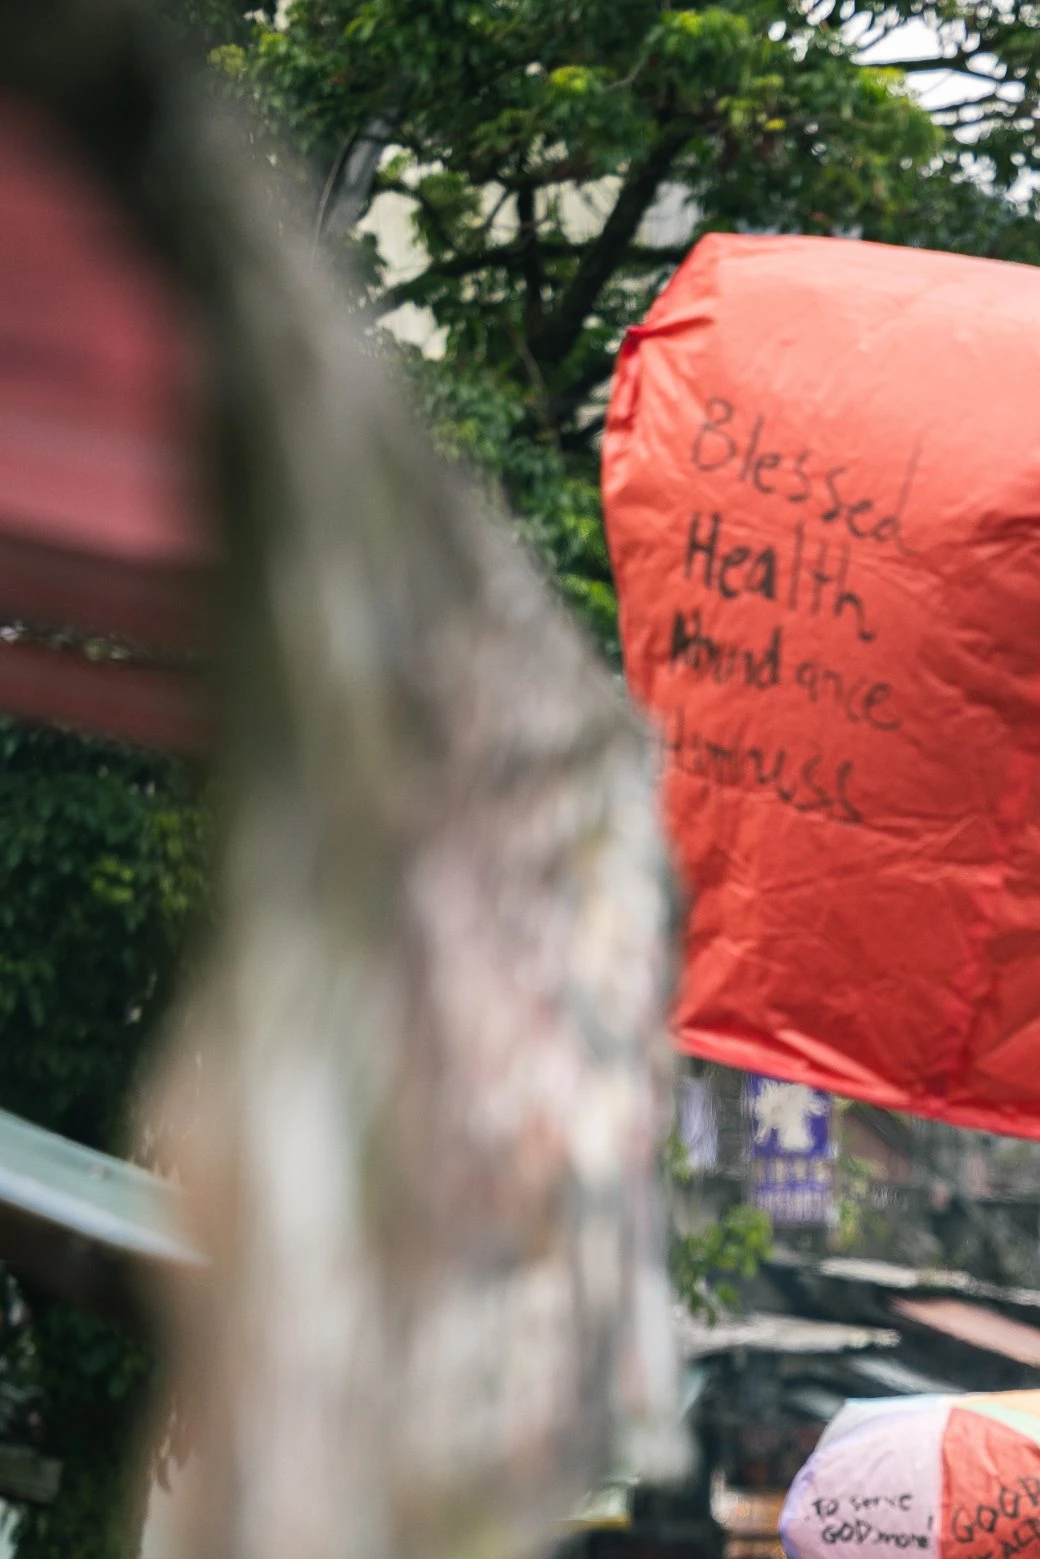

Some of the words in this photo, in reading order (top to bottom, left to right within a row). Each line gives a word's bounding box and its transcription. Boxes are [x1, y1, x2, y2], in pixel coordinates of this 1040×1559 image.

[693, 397, 923, 556] Blessed
[684, 511, 876, 642] Health
[821, 1518, 872, 1544] GOD
